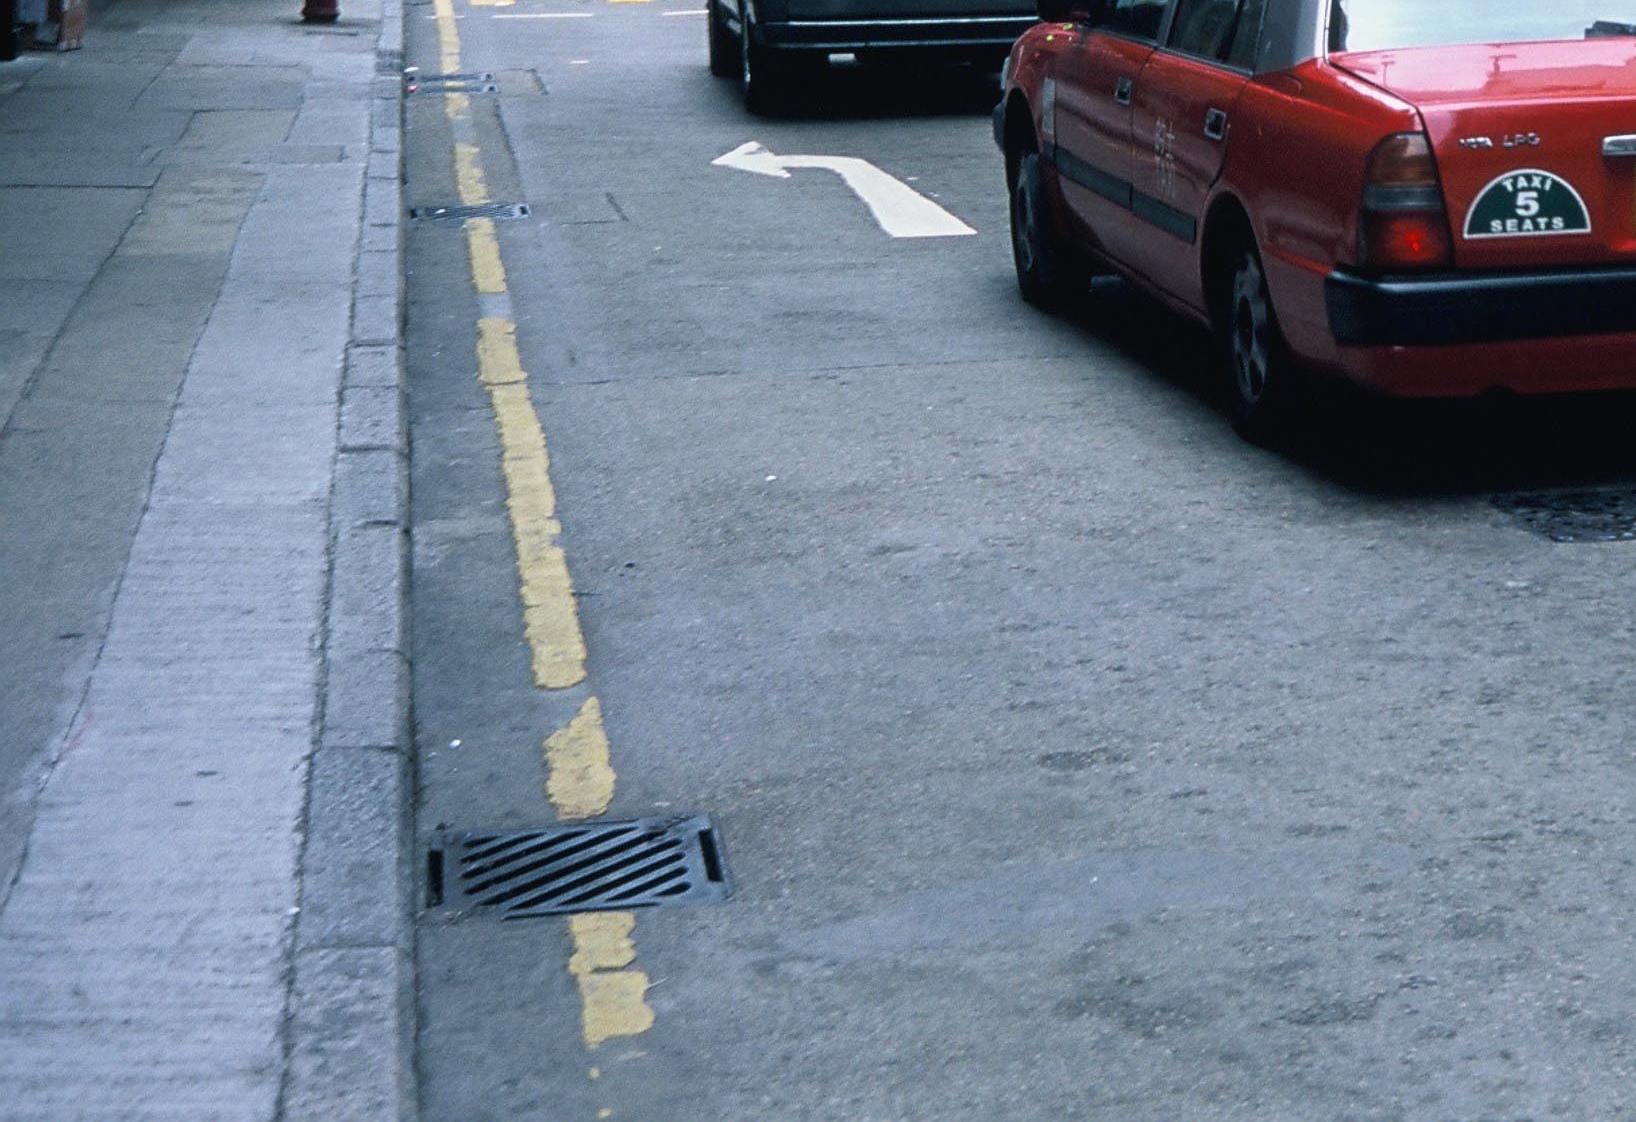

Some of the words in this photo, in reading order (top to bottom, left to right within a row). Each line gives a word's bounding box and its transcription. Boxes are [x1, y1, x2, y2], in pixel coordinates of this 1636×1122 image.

[1503, 133, 1541, 148] LPG
[1502, 175, 1553, 193] TAXI
[1515, 191, 1540, 217] 5
[1490, 216, 1565, 233] SEATS
